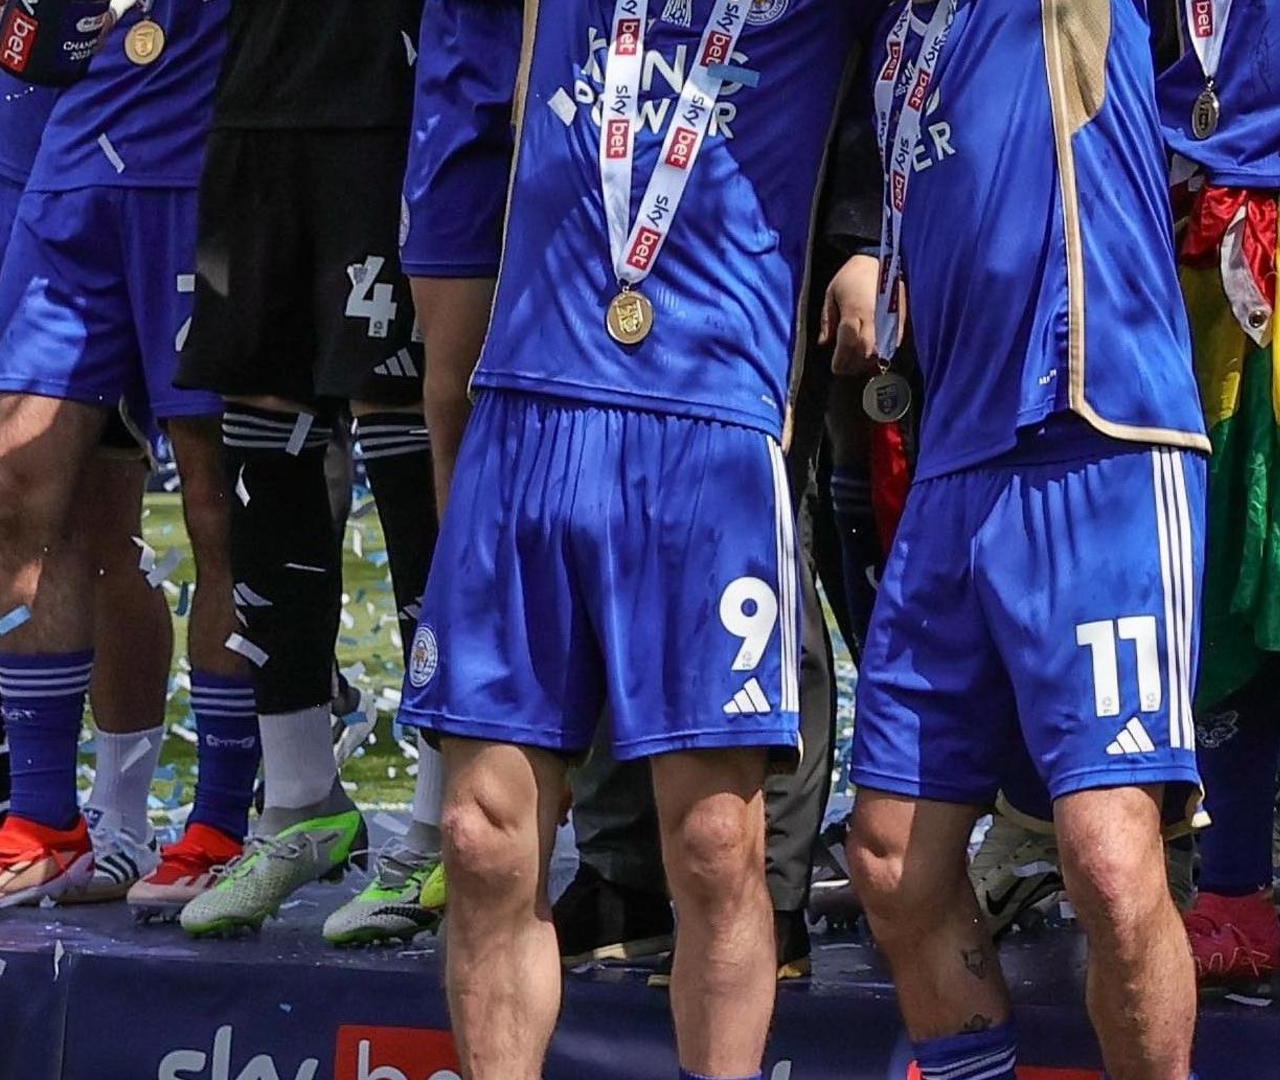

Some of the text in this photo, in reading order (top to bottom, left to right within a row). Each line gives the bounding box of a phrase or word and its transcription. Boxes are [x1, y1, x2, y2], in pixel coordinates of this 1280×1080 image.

[2, 16, 35, 66] bet
[617, 21, 638, 54] bet
[706, 3, 739, 65] sky bet
[1194, 0, 1211, 35] bet
[910, 36, 945, 108] sky bet
[607, 84, 631, 157] sky bet
[668, 94, 704, 166] sky bet
[895, 137, 910, 170] sky
[629, 193, 669, 267] sky bet
[719, 576, 778, 671] 9
[1076, 616, 1161, 718] 11
